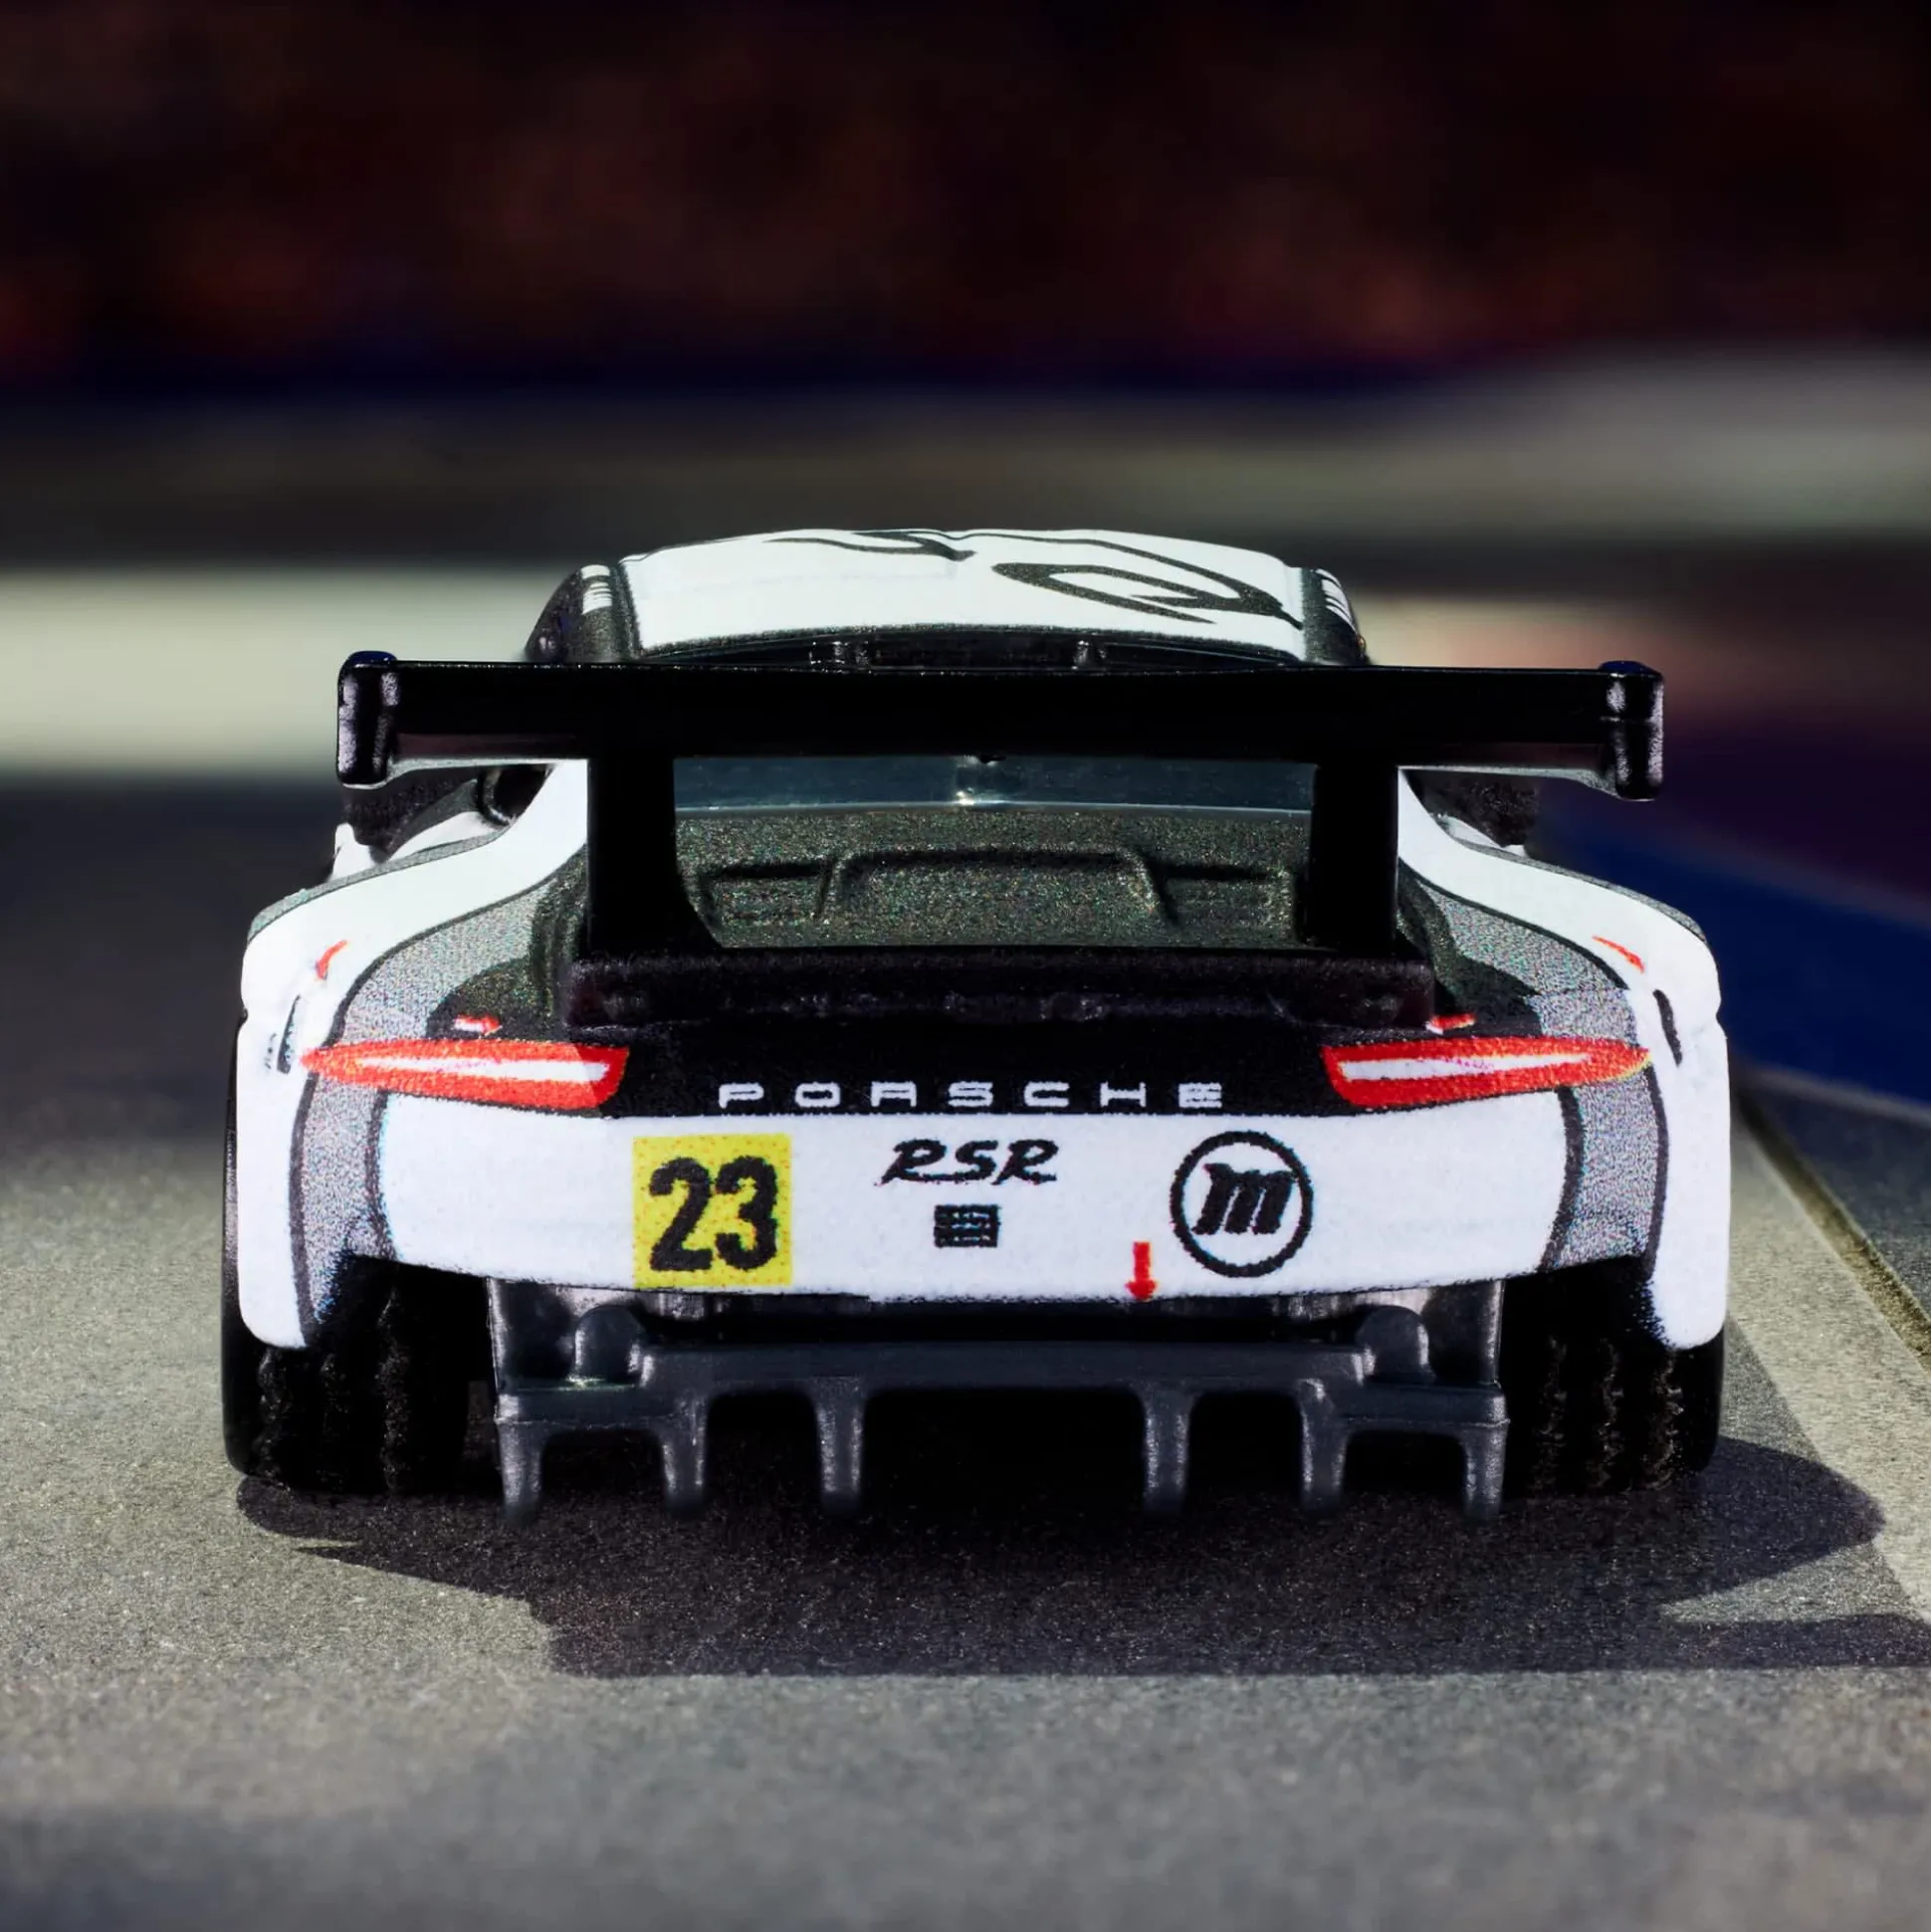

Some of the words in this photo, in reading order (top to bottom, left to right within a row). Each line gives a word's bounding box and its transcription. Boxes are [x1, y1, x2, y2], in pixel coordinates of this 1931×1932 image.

[718, 1081, 1222, 1108] PORSCHE
[875, 1138, 1059, 1186] RSR
[648, 1155, 779, 1273] 23
